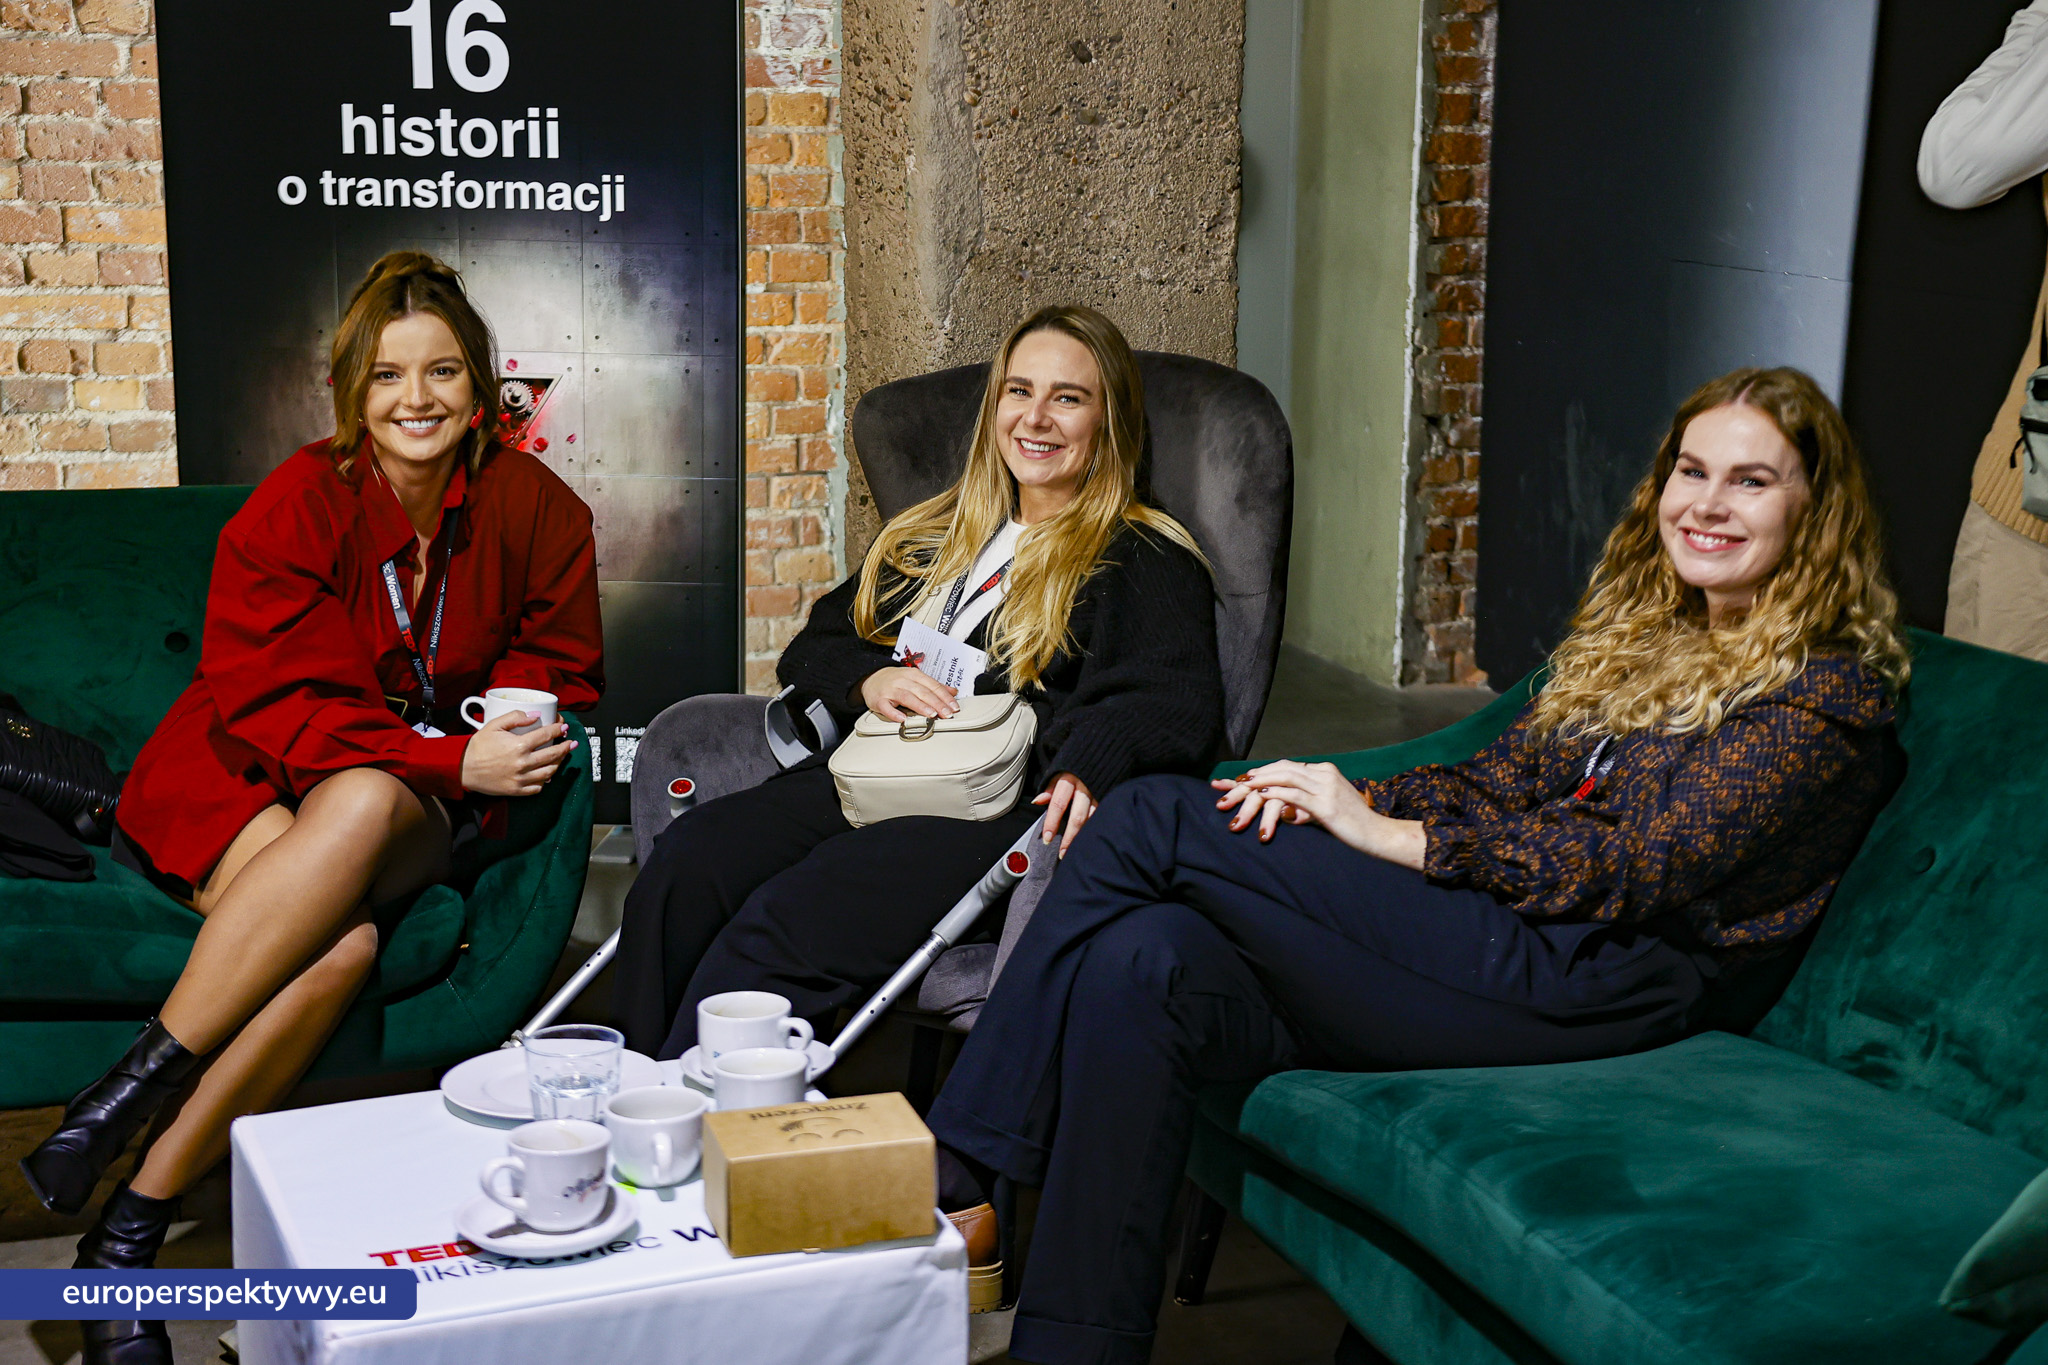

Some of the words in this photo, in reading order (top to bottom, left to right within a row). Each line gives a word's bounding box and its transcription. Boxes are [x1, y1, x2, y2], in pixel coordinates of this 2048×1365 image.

[390, 0, 510, 93] 16
[341, 103, 560, 158] historii
[277, 175, 307, 205] o
[319, 170, 626, 221] transformacji
[385, 574, 401, 610] Women
[945, 656, 959, 687] zestnik
[368, 1240, 484, 1267] TED
